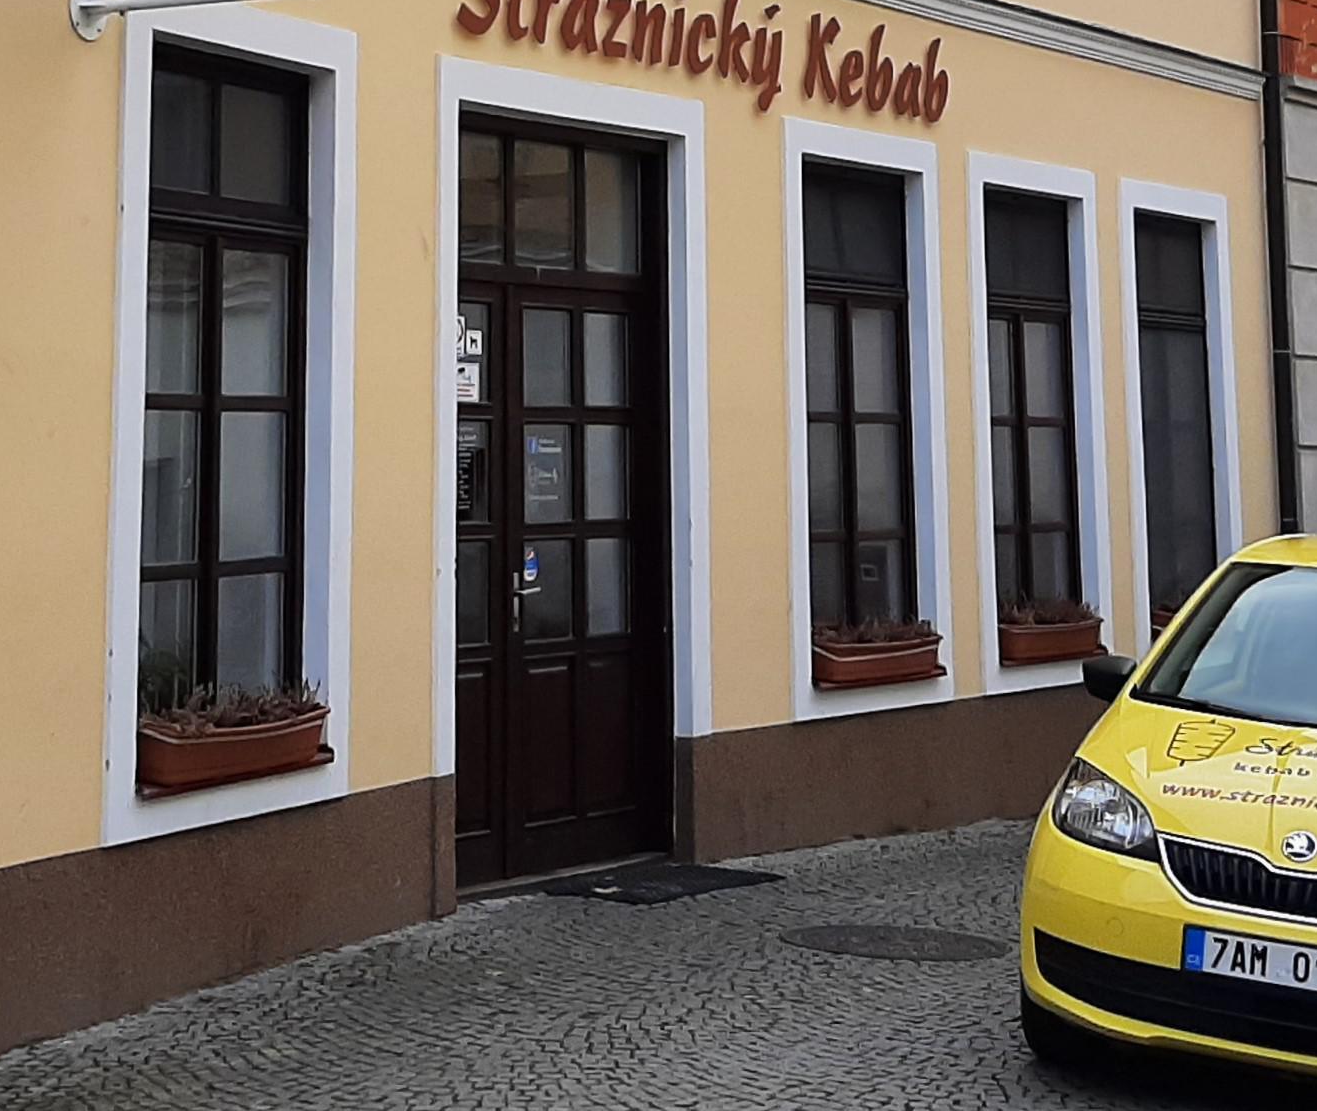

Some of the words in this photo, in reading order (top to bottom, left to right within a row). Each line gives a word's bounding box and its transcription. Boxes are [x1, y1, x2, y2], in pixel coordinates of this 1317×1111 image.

[803, 11, 950, 124] Kebab
[1234, 762, 1311, 778] kebab
[1211, 937, 1268, 977] 7AM
